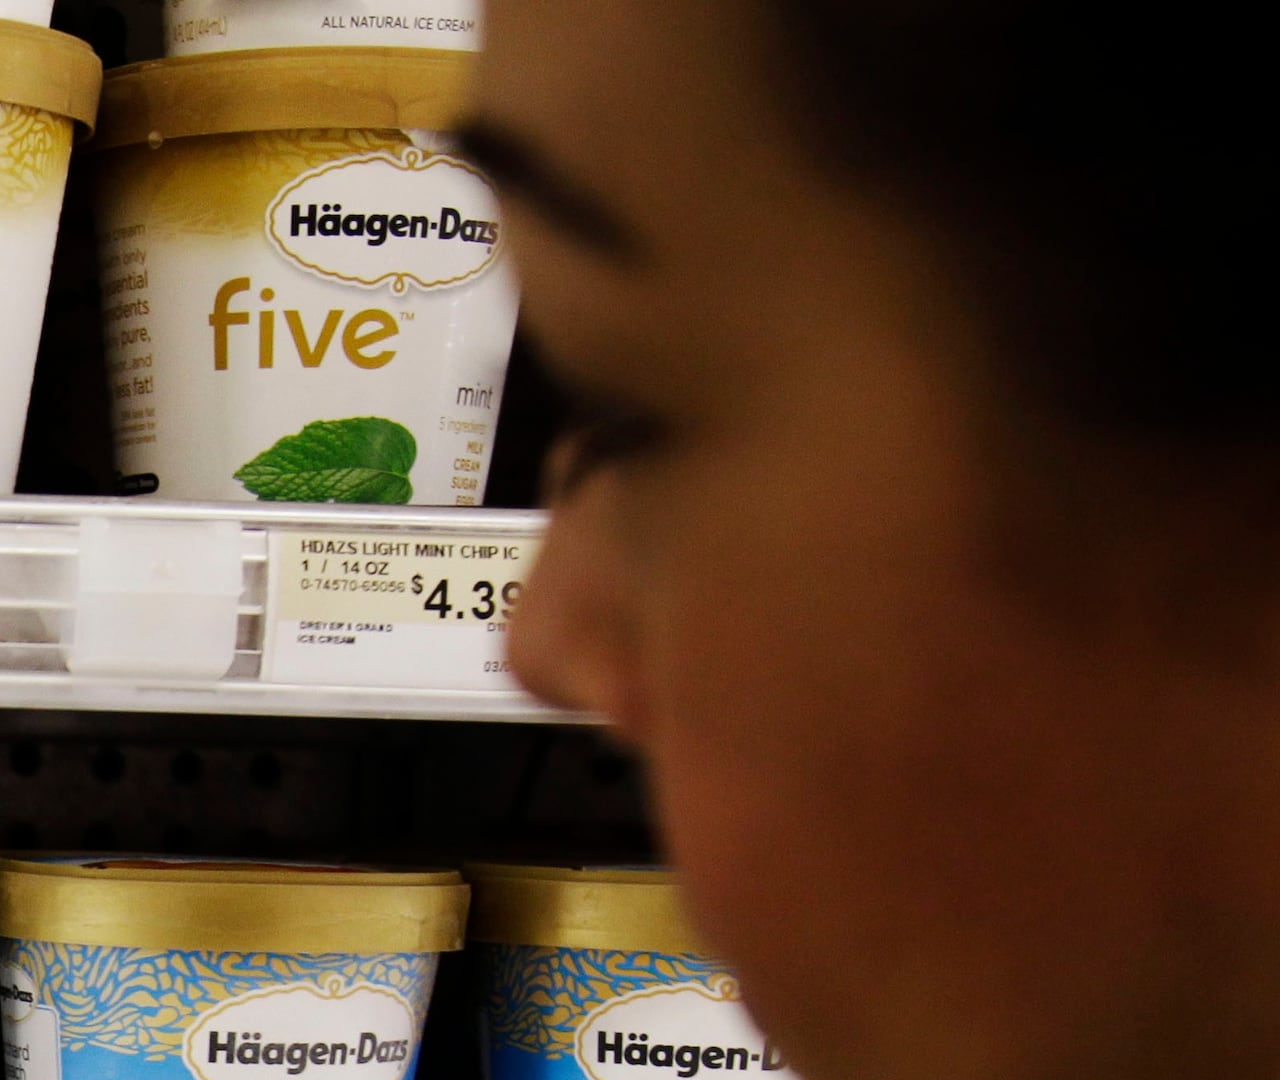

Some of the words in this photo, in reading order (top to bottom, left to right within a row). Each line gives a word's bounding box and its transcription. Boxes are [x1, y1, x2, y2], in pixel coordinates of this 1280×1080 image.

[322, 16, 345, 29] ALL
[350, 16, 408, 31] NATURAL
[414, 17, 434, 31] ICE
[437, 19, 474, 33] CREAM
[209, 277, 399, 372] five
[456, 384, 493, 411] mint
[301, 539, 357, 554] HDAZS
[362, 541, 409, 556] LIGHT
[415, 543, 454, 558] MINT
[460, 545, 499, 559] CHIP
[503, 546, 519, 560] IC
